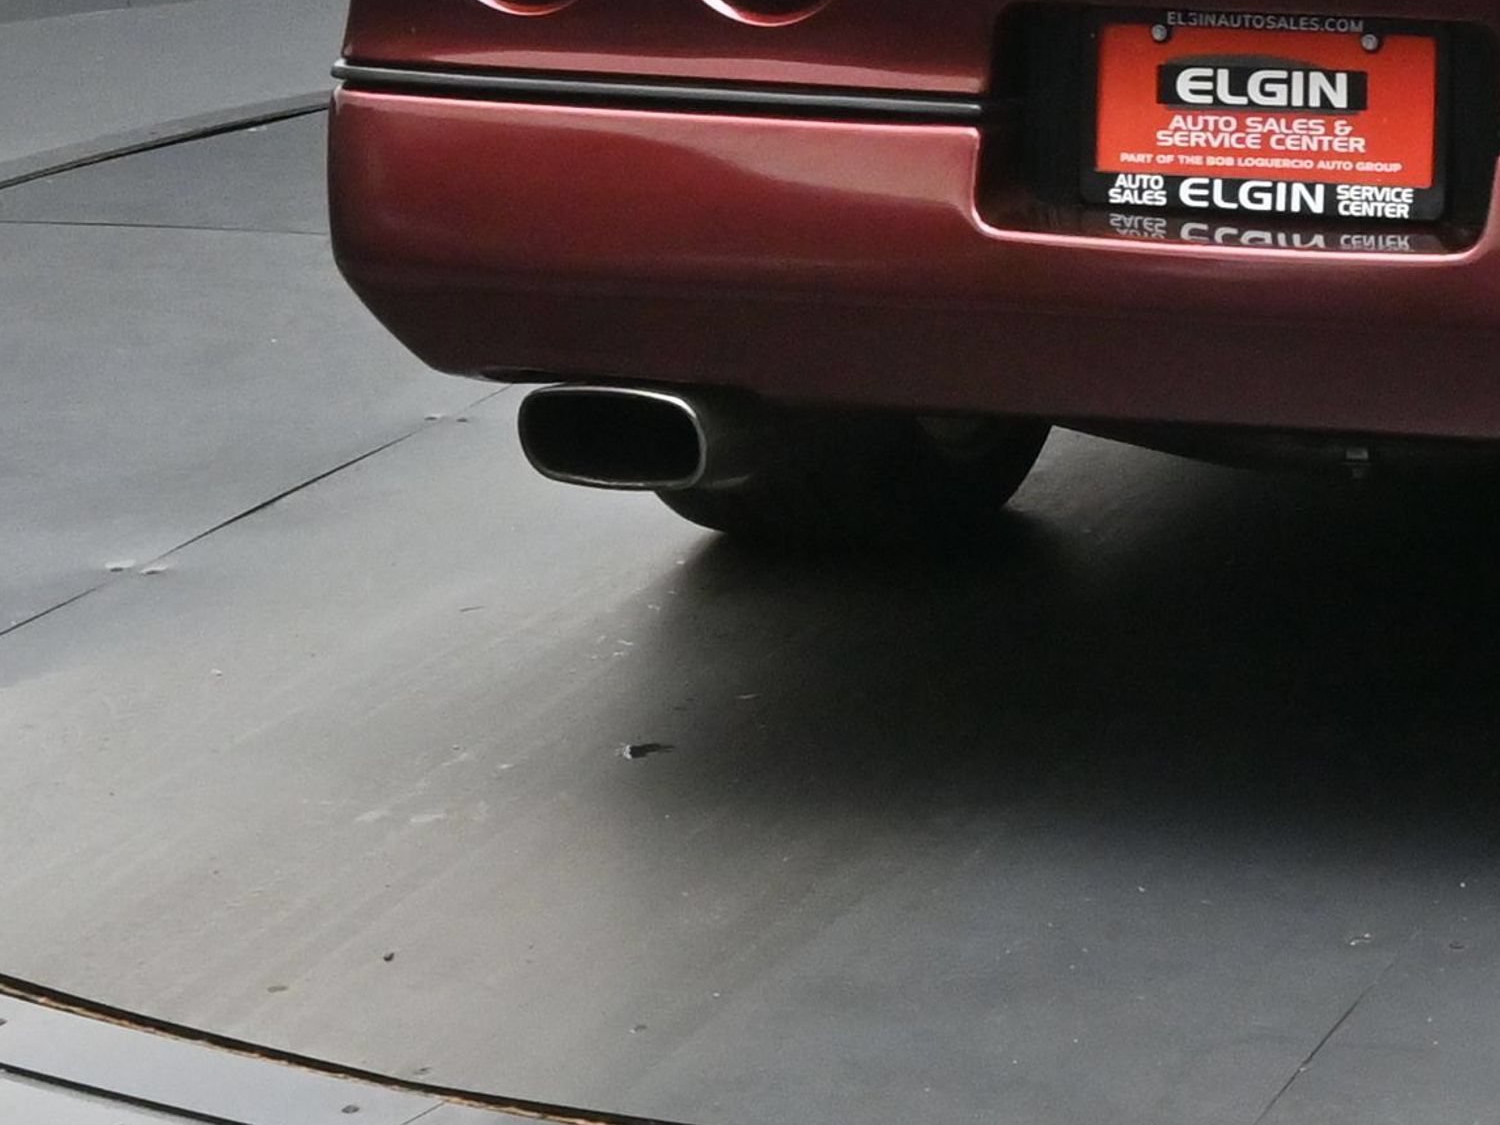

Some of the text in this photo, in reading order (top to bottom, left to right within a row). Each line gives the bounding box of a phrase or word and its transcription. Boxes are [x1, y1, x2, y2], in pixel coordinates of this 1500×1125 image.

[1175, 67, 1348, 109] ELGIN
[1168, 114, 1353, 136] AUTO SALES &
[1156, 131, 1366, 153] SERVICE CENTER
[1120, 152, 1153, 164] PART
[1156, 154, 1174, 165] OF
[1178, 155, 1203, 166] THE
[1206, 156, 1234, 167] BOB
[1317, 159, 1353, 172] AUTO
[1356, 161, 1402, 174] GROUP
[1114, 173, 1164, 189] AUTO
[1108, 188, 1168, 206] SALES
[1178, 177, 1325, 214] ELGIN
[1336, 185, 1414, 203] SERVICE
[1337, 200, 1410, 219] CENTER
